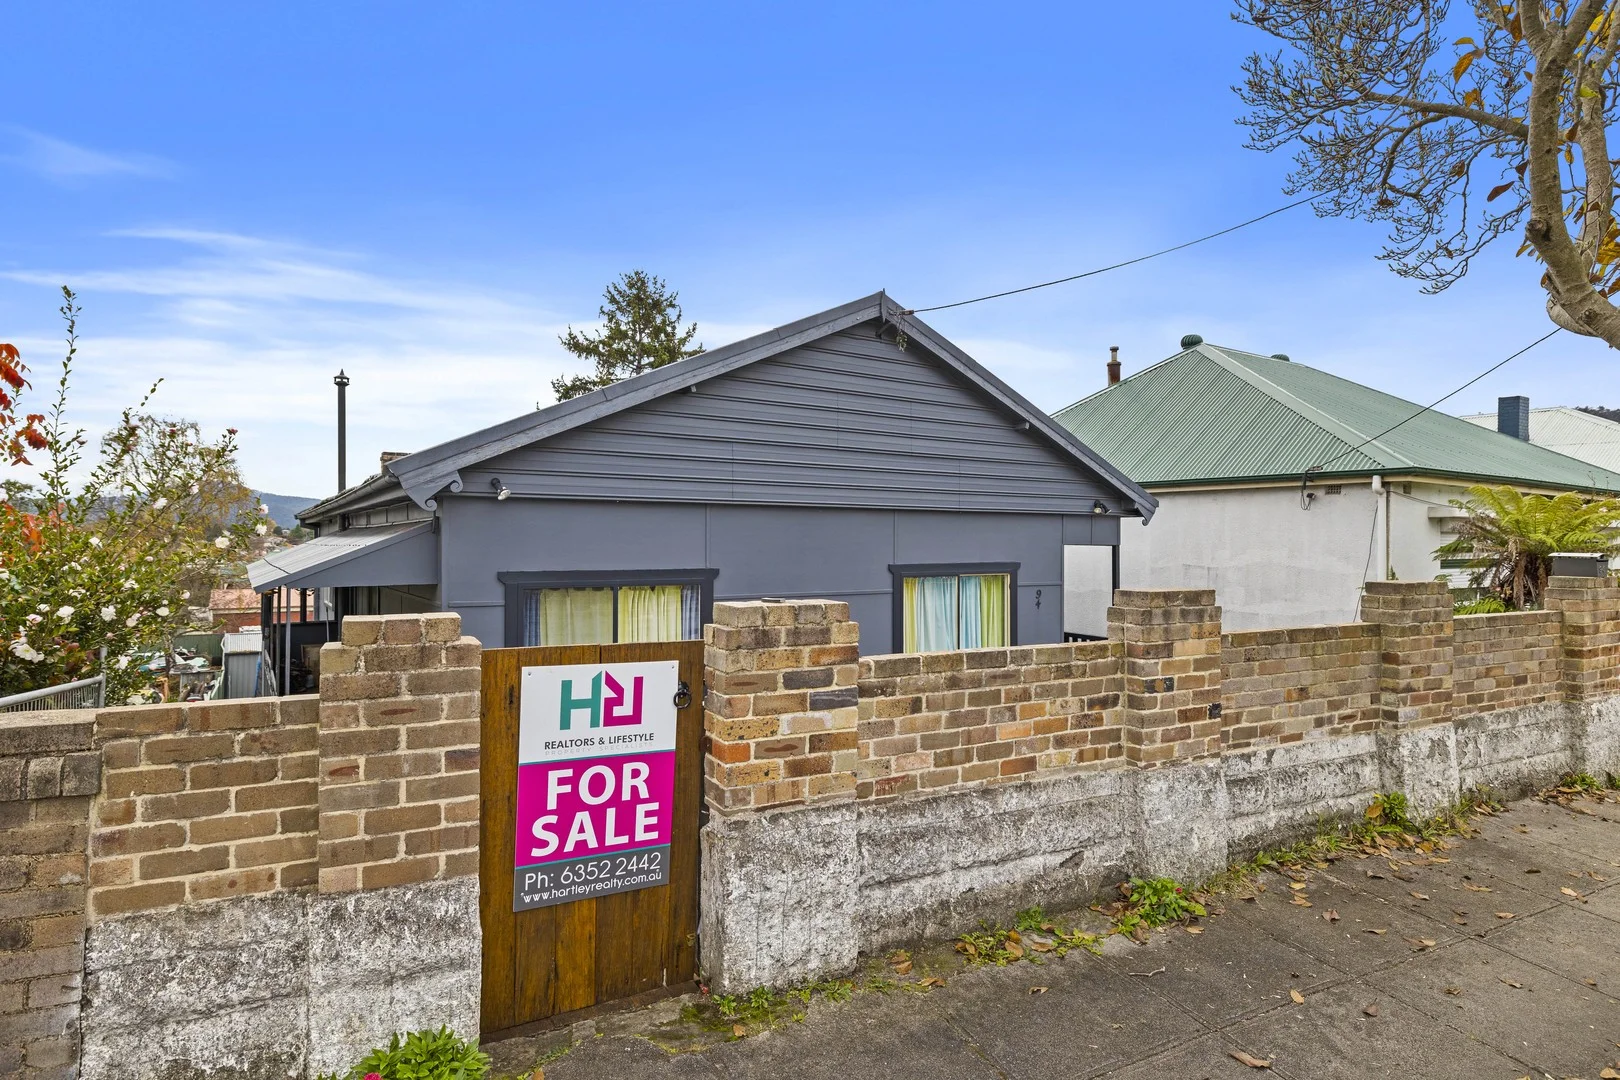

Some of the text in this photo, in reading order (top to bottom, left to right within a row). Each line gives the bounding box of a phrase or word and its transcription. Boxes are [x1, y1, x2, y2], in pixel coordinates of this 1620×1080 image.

[544, 732, 655, 750] REALTORS & LIFESTYLE
[545, 742, 654, 756] PROPERTY SPECIALISTS
[546, 761, 650, 811] FOR
[530, 801, 660, 858] SALE
[523, 871, 662, 903] www.hartleyrealty.com.au
[524, 852, 661, 891] Ph: 6352 2442
